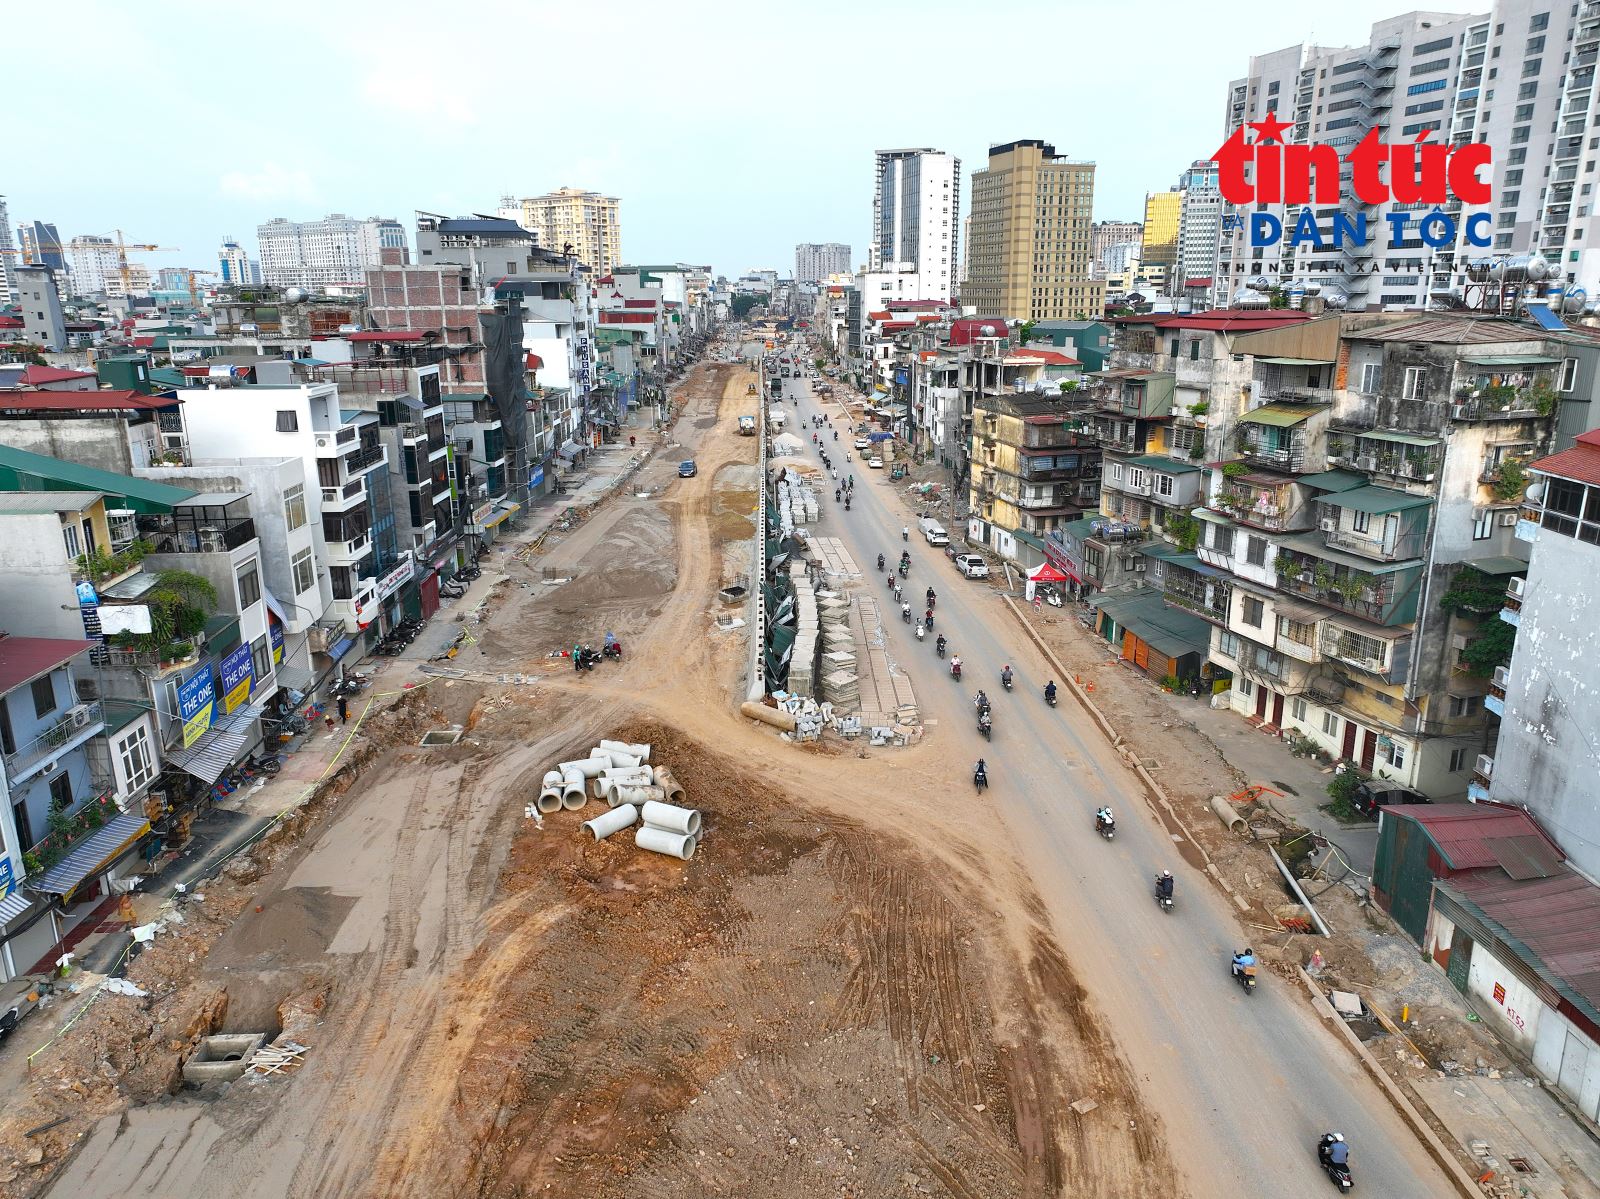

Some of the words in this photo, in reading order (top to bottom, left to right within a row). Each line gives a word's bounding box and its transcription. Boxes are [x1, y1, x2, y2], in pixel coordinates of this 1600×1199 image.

[225, 670, 239, 688] THE
[238, 659, 251, 677] ONE
[183, 695, 198, 716] THE
[198, 682, 212, 702] ONE
